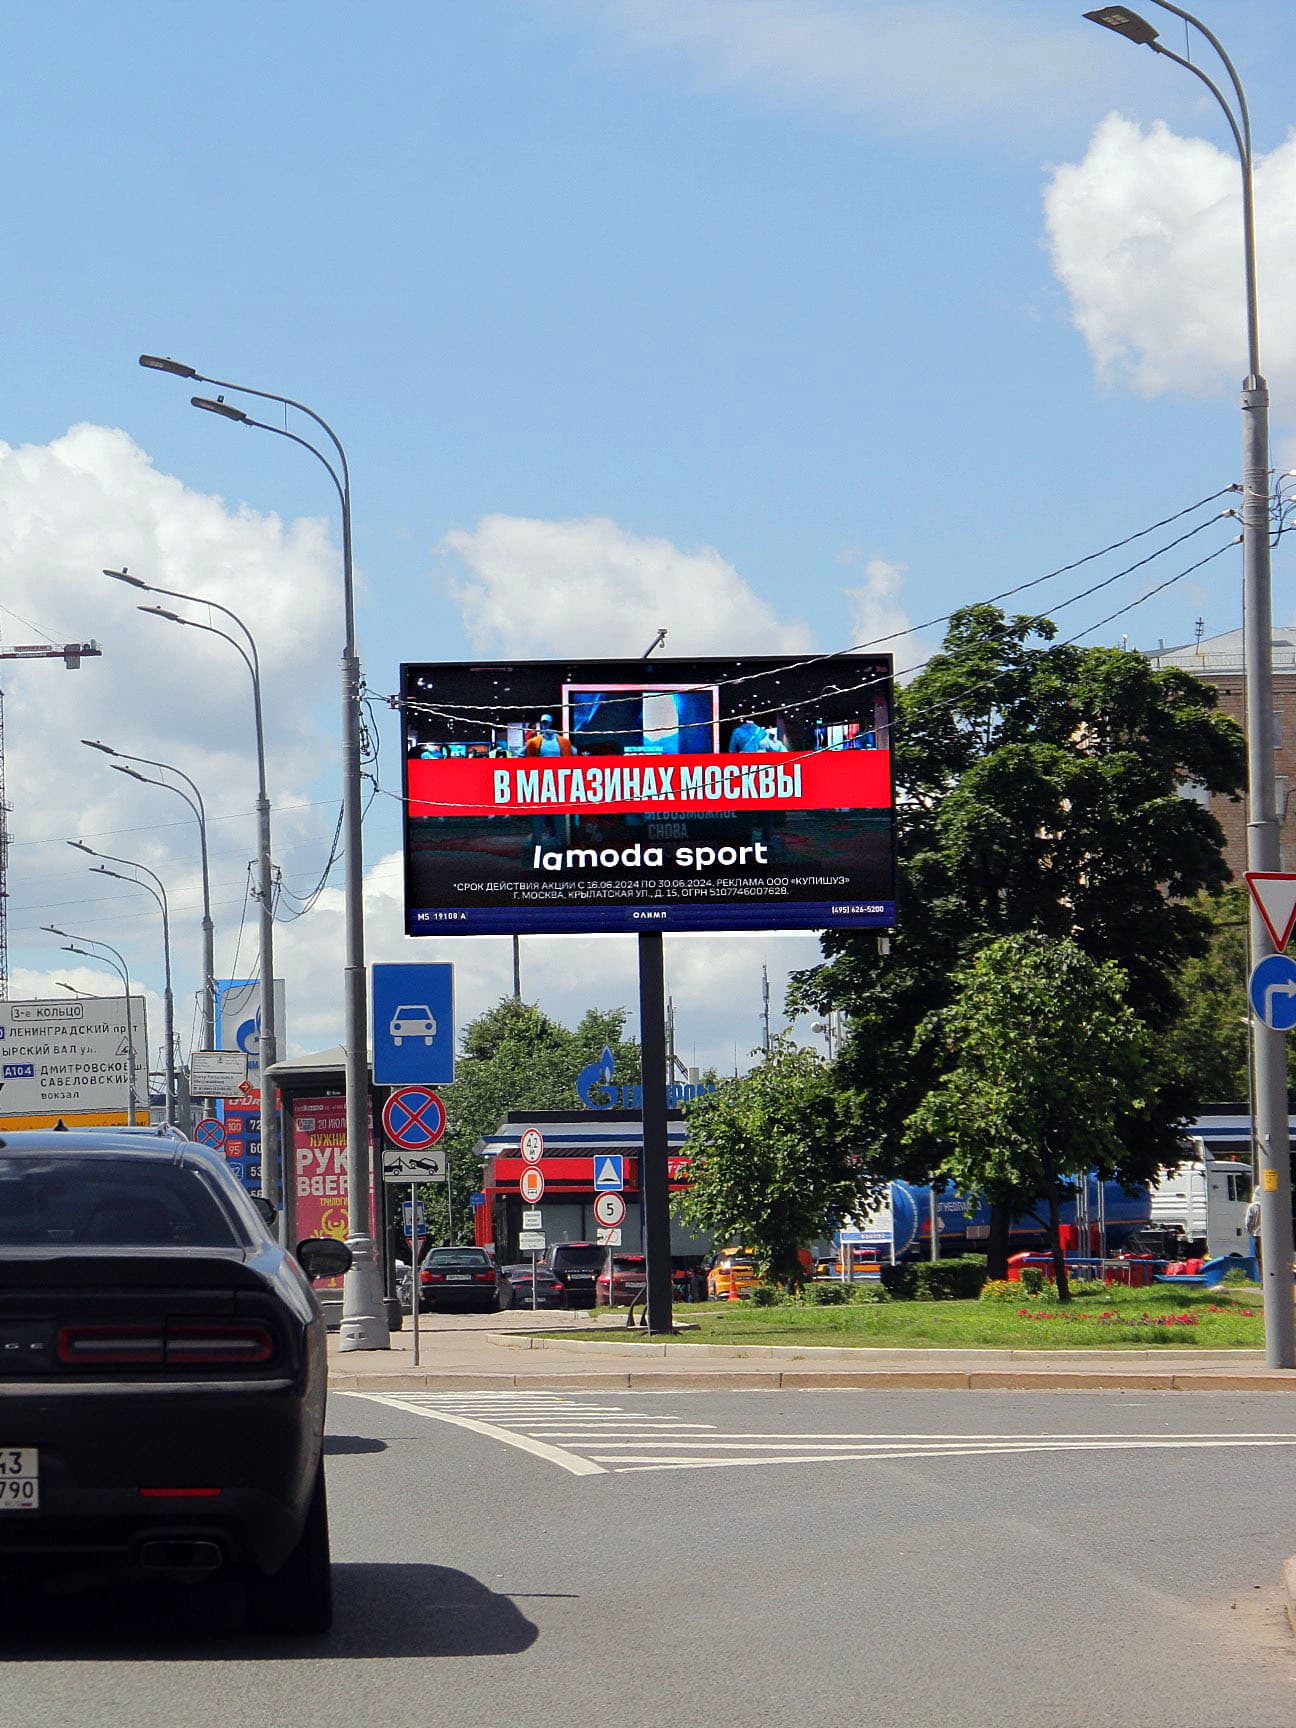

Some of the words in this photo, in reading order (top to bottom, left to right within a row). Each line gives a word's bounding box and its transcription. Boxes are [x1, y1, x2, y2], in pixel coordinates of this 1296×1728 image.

[494, 769, 510, 803] В
[517, 767, 674, 803] МАГАЗИНАХ
[681, 763, 802, 801] МОСКВЫ
[533, 844, 663, 871] lamoda
[675, 844, 768, 871] sport
[486, 880, 539, 892] ДЕЙСТВИЯ
[541, 881, 576, 891] АКЦИИ
[641, 880, 656, 889] ПО
[716, 878, 765, 888] РЕКЛАМА
[767, 878, 789, 887] ООО
[568, 890, 633, 899] КРЫЛАТСКАЯ
[682, 888, 707, 897] ОГРН
[632, 911, 667, 920] ОЛИМП
[37, 1006, 81, 1018] КОЛЬЦО
[9, 1023, 110, 1038] ЛЕНИНГРАДСКИЙ
[113, 1025, 138, 1036] прт
[53, 1045, 77, 1055] ВАЛ
[40, 1063, 128, 1076] ДМИТРОВСКОЕ
[41, 1091, 80, 1100] вокзал
[328, 1118, 347, 1129] ИЮЛ
[309, 1132, 347, 1147] ЛУЖНИ
[228, 1145, 240, 1155] 95
[606, 1203, 614, 1216] 5
